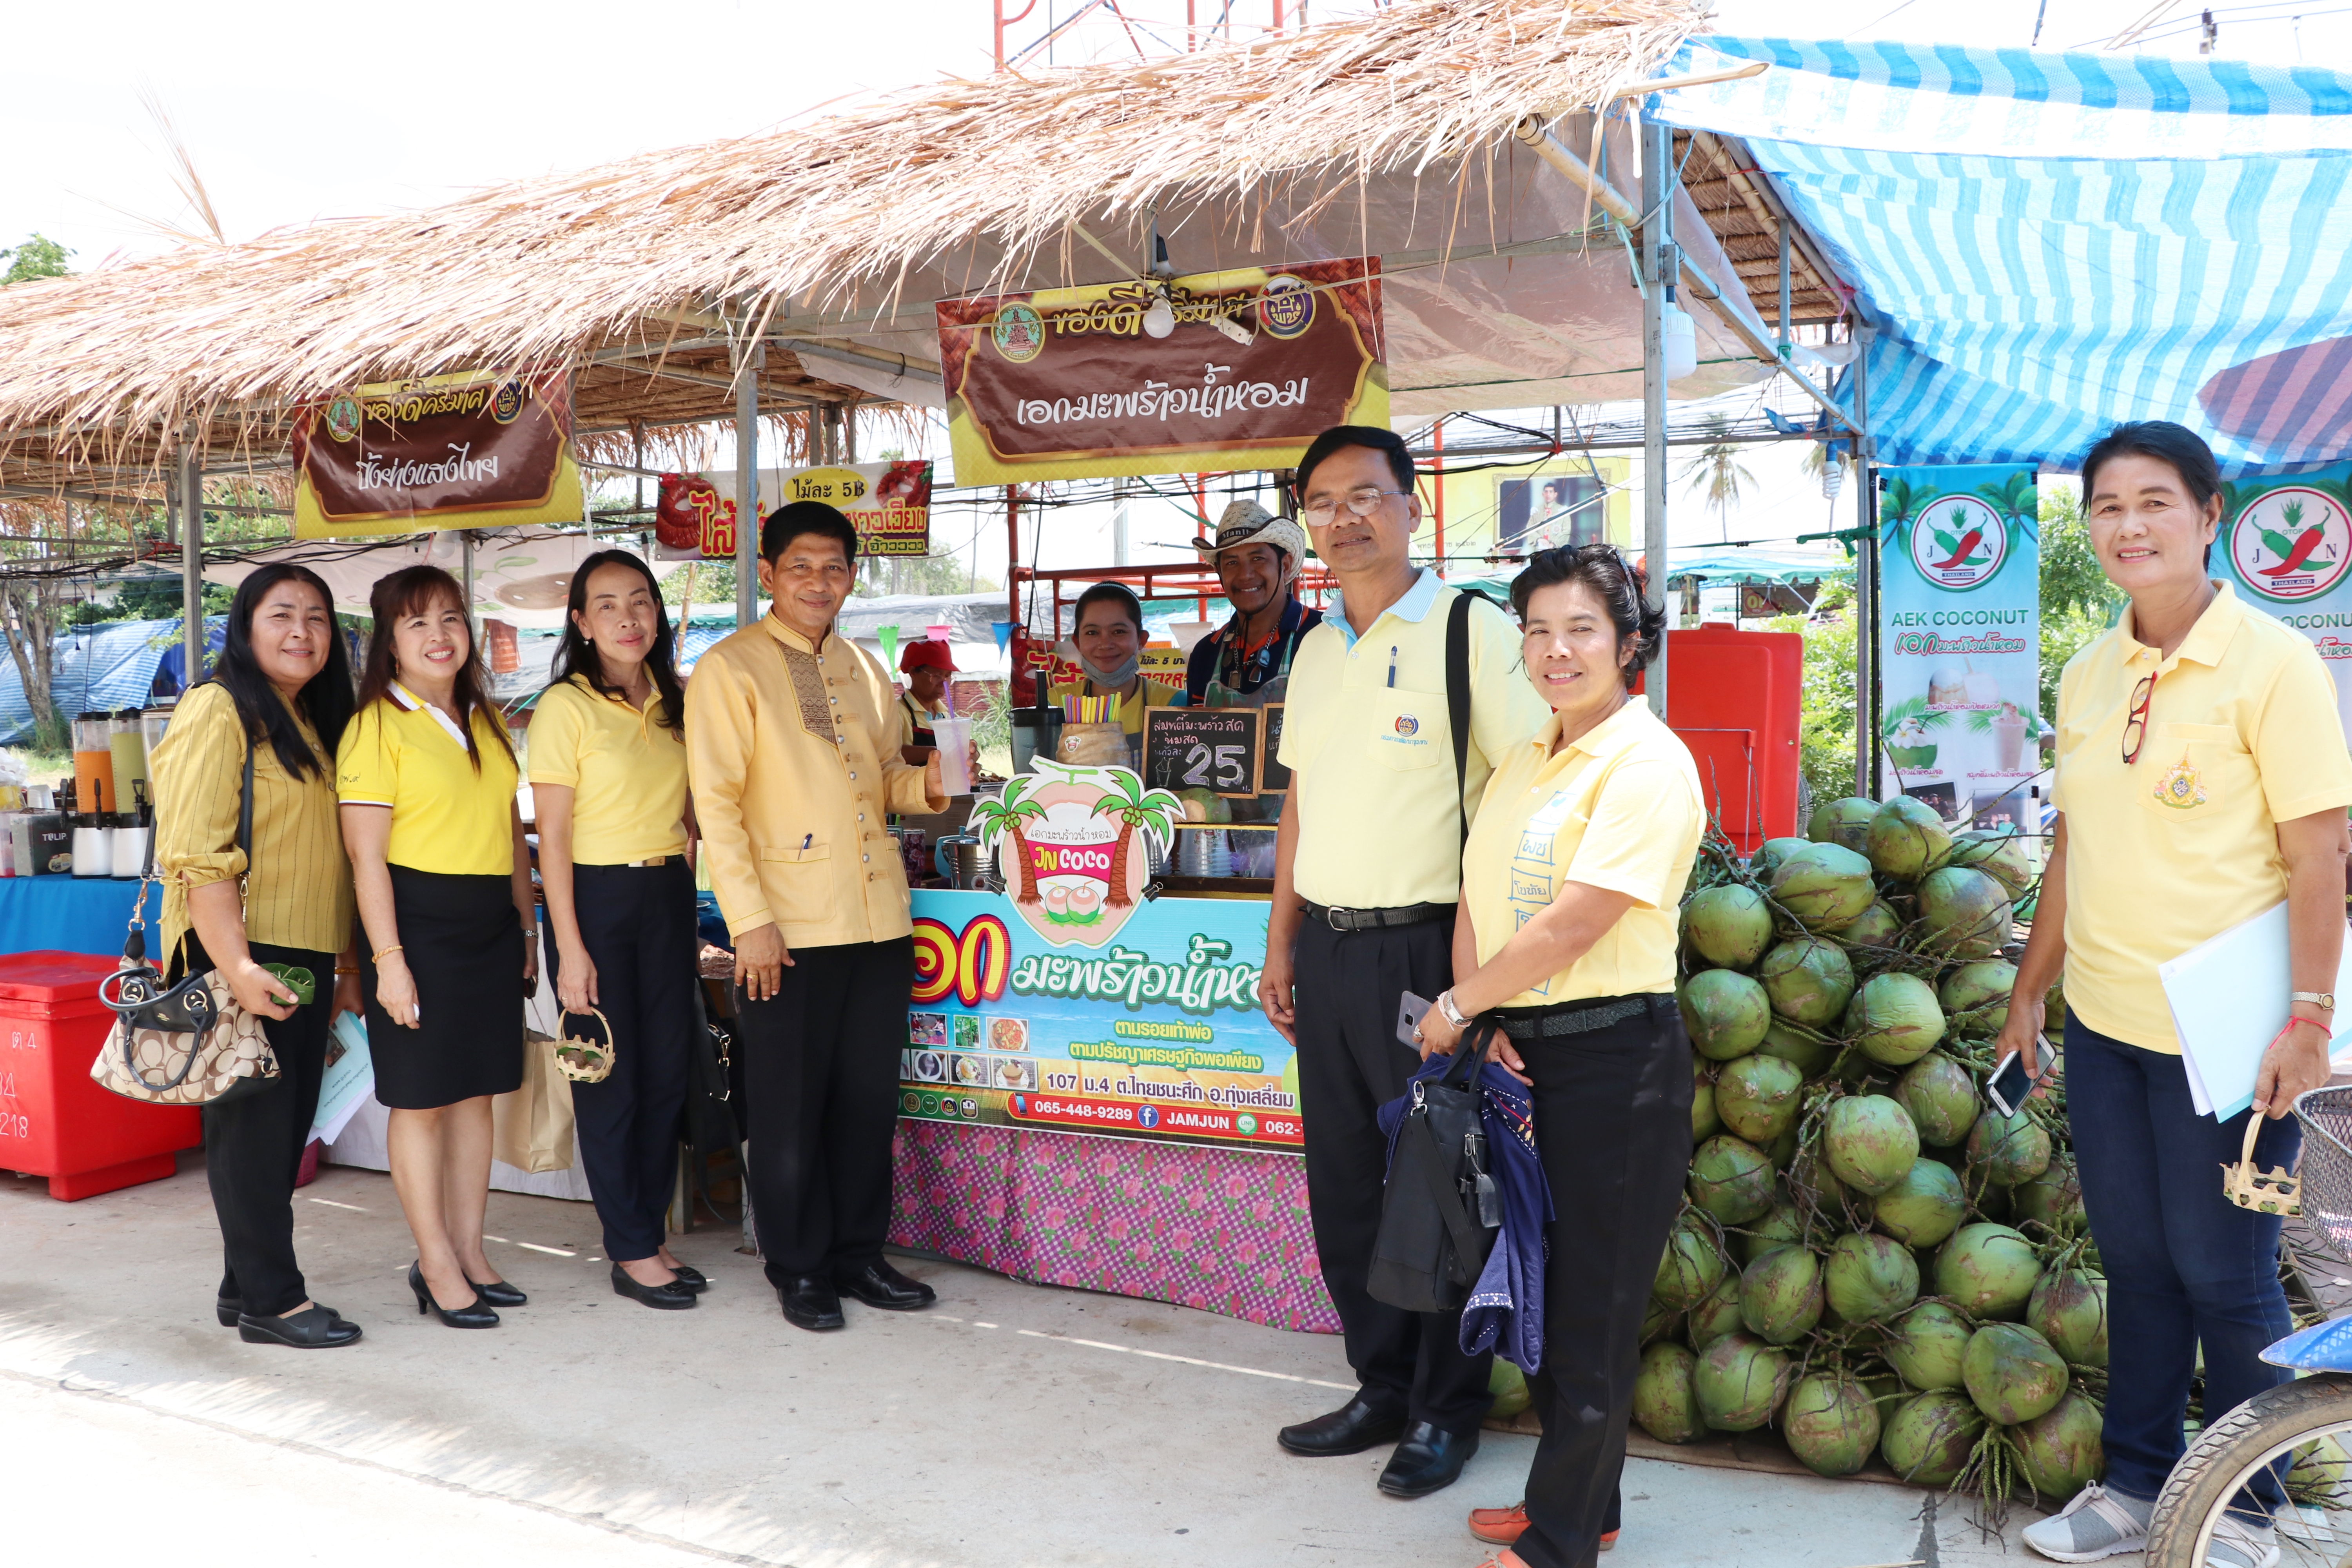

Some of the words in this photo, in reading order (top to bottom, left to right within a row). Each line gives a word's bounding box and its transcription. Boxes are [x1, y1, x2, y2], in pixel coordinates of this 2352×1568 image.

[1017, 362, 1309, 425] เอกมะพร้าวน้ำหอม
[793, 479, 832, 498] ไม้ละ
[1926, 545, 1933, 558] J
[1984, 543, 1992, 556] N
[2252, 548, 2260, 563] J
[2325, 543, 2337, 559] N
[1891, 611, 1928, 626] AEK
[1933, 609, 2029, 626] COCONUT
[2277, 612, 2352, 629] OCONU
[1181, 743, 1246, 786] 25
[42, 832, 67, 842] TULIP
[911, 915, 1010, 1006] อก
[1012, 936, 1262, 1009] มะพร้าวน้ำห
[1114, 1020, 1212, 1040] ตามรอยเท้าพ่อ
[1069, 1042, 1261, 1069] ตามปรัชญาเศรษฐกิจพอเพียง
[1047, 1073, 1077, 1089] 107
[1084, 1078, 1109, 1092] ม.4
[1117, 1075, 1202, 1100] ต.ไทยชนะศึก
[1210, 1084, 1294, 1108] อ.ทุ่งเสลี่ยม
[1034, 1101, 1133, 1121] 065-448-9289
[1167, 1112, 1229, 1129] JAMJUN
[1265, 1121, 1303, 1136] 062-
